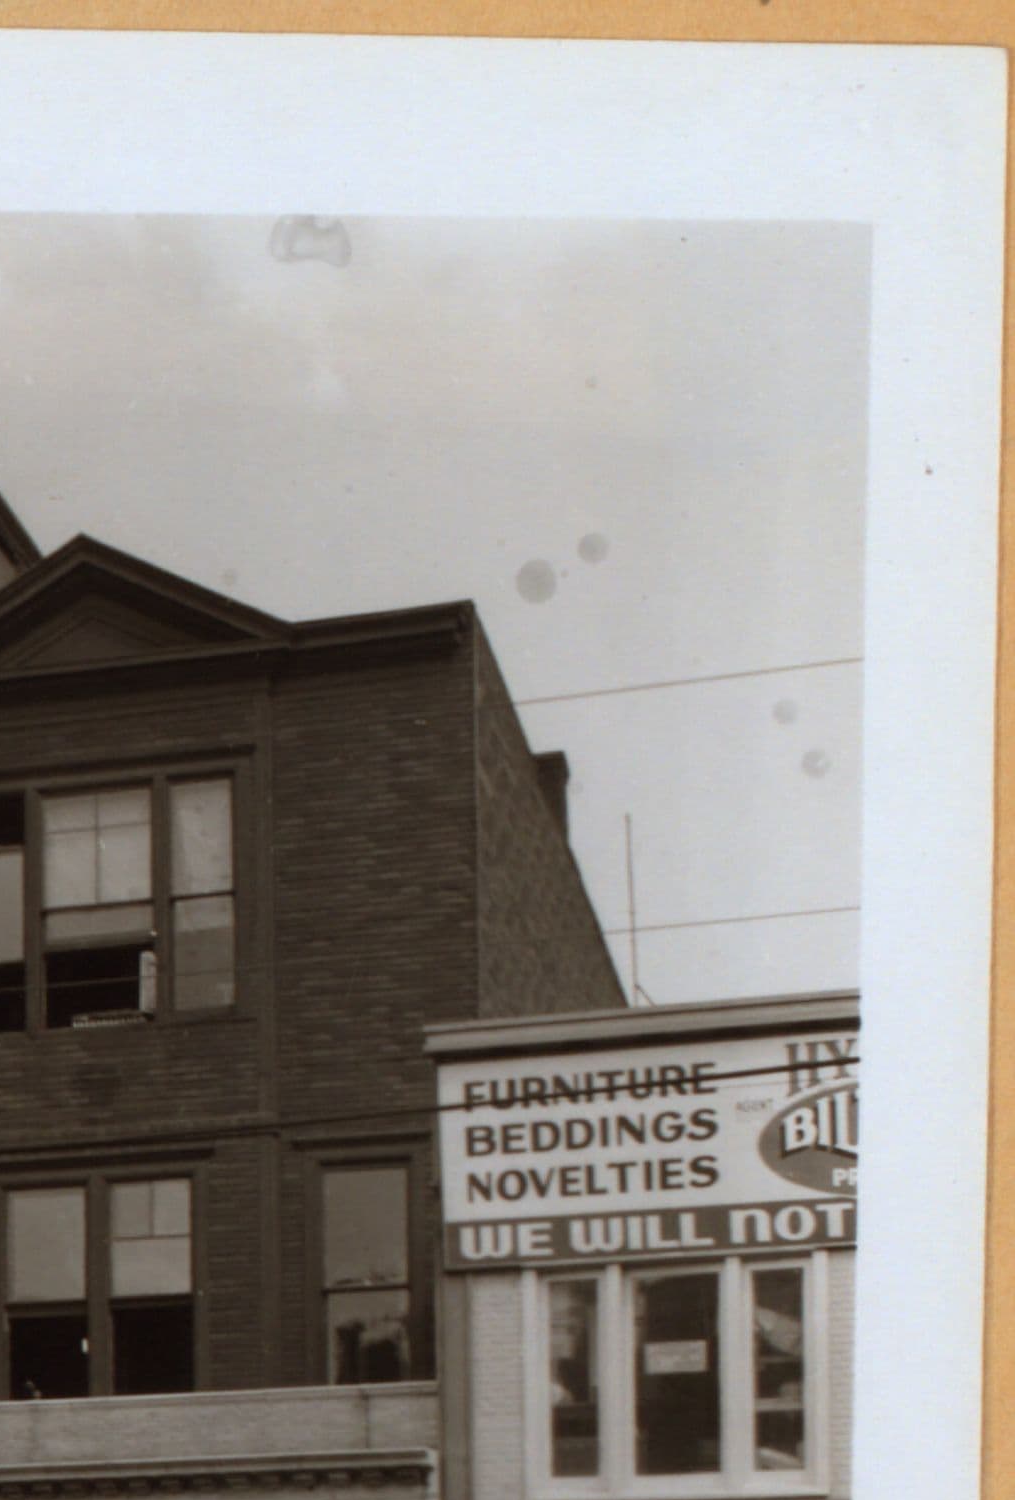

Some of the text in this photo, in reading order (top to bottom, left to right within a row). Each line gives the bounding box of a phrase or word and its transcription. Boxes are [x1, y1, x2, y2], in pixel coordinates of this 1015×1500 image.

[462, 1062, 718, 1113] FURNITURE
[465, 1108, 719, 1157] BEDDINGS
[467, 1155, 719, 1203] NOVELTIES
[459, 1202, 854, 1260] WE WILL NOT
